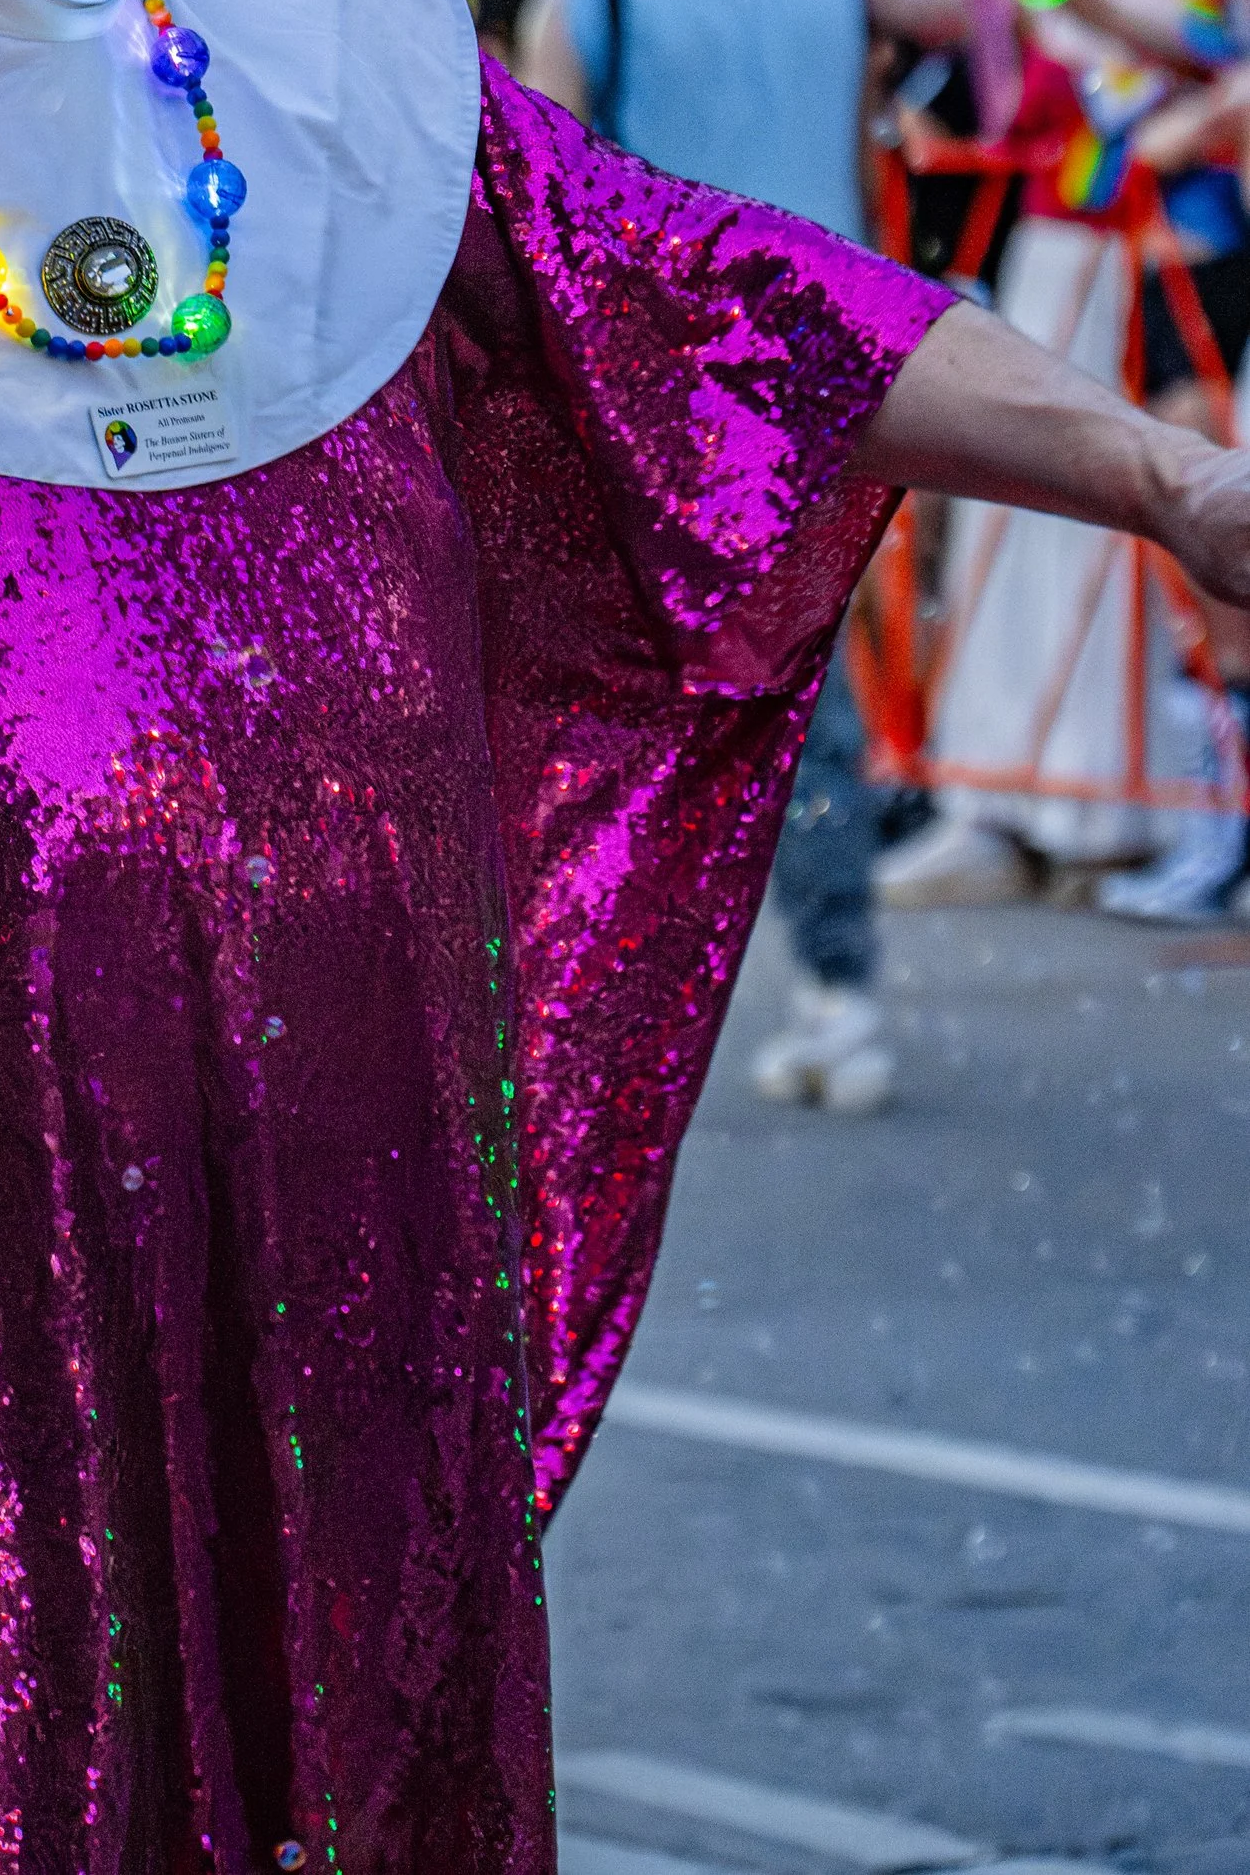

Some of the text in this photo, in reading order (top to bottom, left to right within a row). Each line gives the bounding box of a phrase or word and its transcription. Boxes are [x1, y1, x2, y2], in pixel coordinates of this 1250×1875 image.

[97, 389, 218, 418] Sister ROSETTA STONE
[158, 414, 205, 427] All Pronouns
[145, 437, 159, 448] The
[189, 430, 215, 441] Sisters
[217, 425, 225, 438] of
[149, 445, 187, 462] Perpetual
